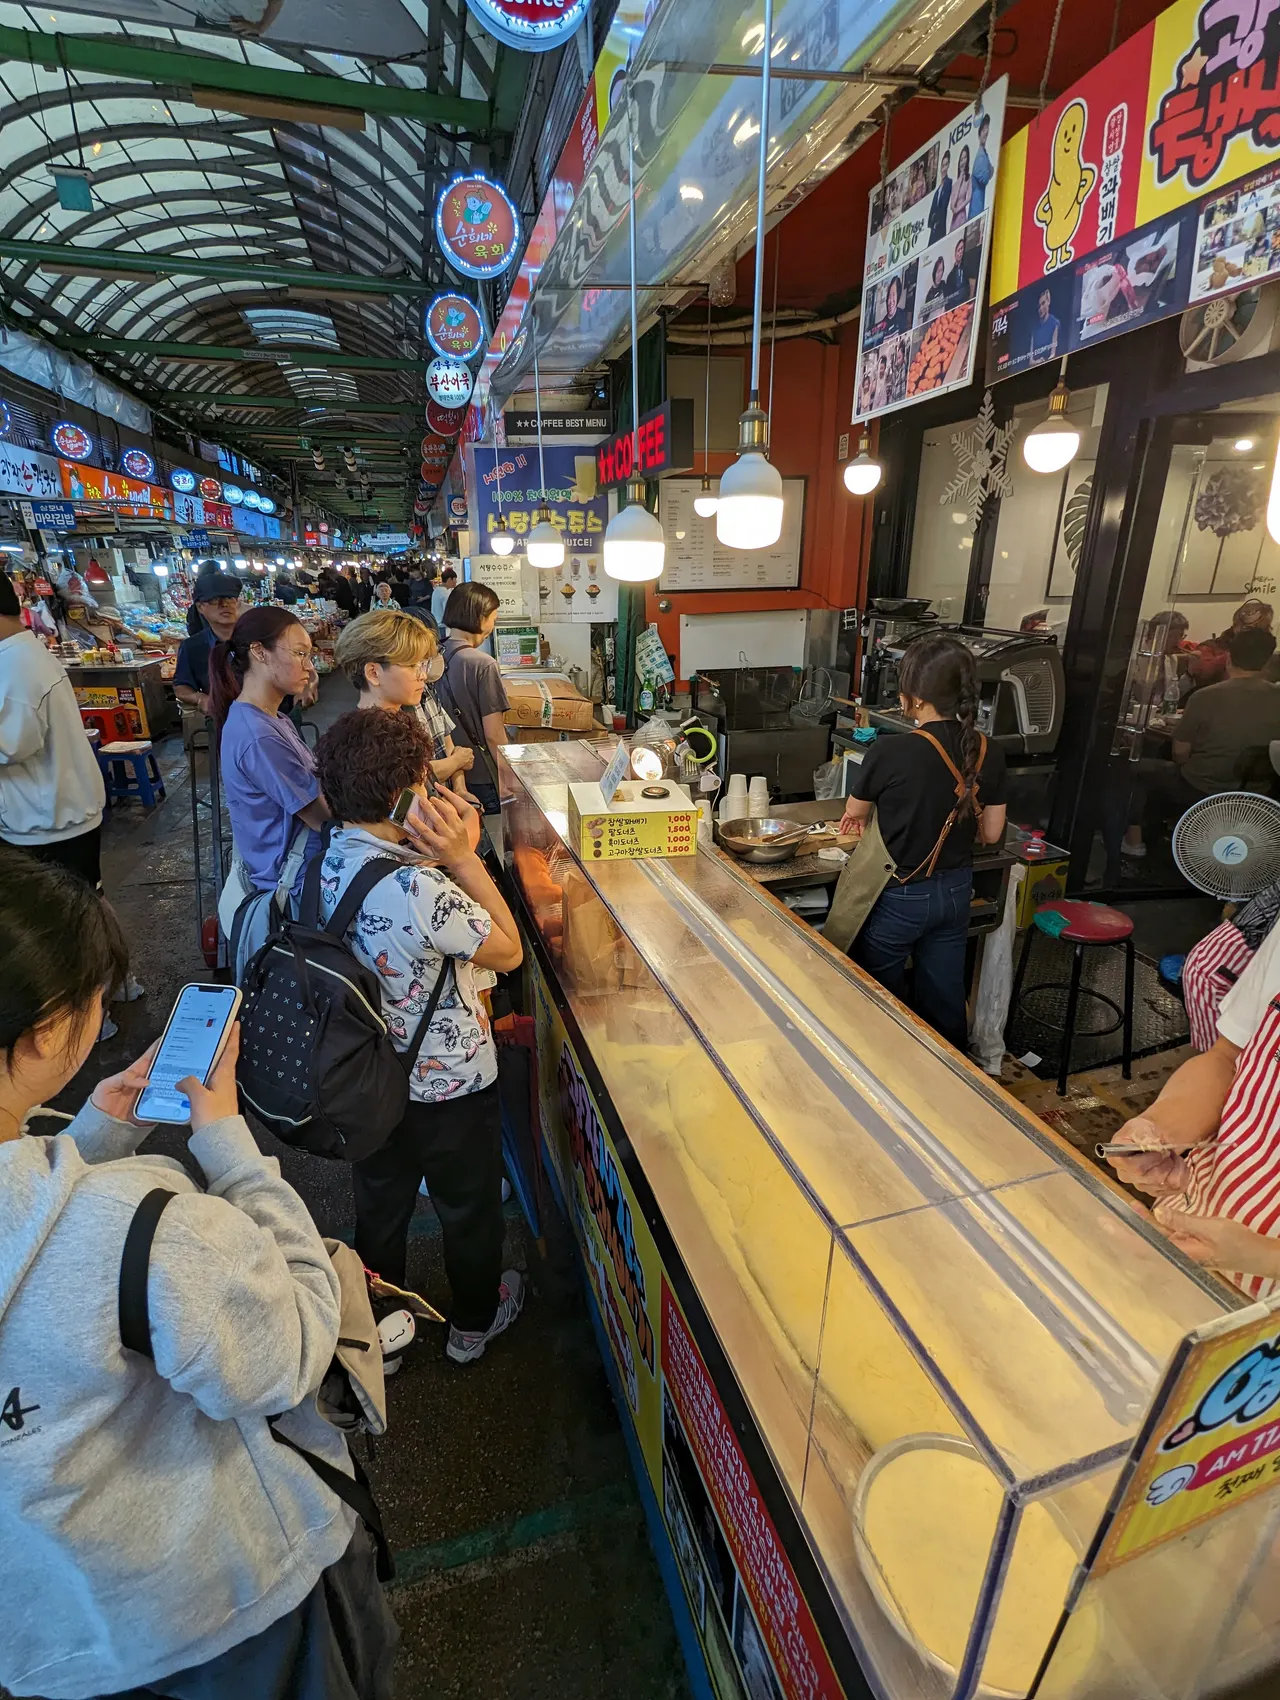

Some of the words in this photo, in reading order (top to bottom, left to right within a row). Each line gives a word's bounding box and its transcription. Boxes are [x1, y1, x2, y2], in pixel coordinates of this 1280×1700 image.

[949, 115, 972, 149] KBS
[1099, 174, 1118, 242] 꽈배기
[474, 244, 504, 259] 육회
[451, 340, 473, 350] 육회
[430, 372, 470, 392] 부산어묵
[530, 418, 564, 429] COFFEE
[565, 418, 584, 428] BEST
[585, 417, 607, 428] MENU
[614, 414, 666, 479] COFEE
[491, 490, 524, 502] 100%
[35, 513, 75, 526] 마약김밥
[1244, 582, 1277, 595] Smile
[499, 598, 516, 606] 수쥬스
[607, 817, 648, 827] 찹쌀꽈배기
[607, 847, 663, 857] 고구마찹쌀도너츠
[1204, 1444, 1249, 1477] AM
